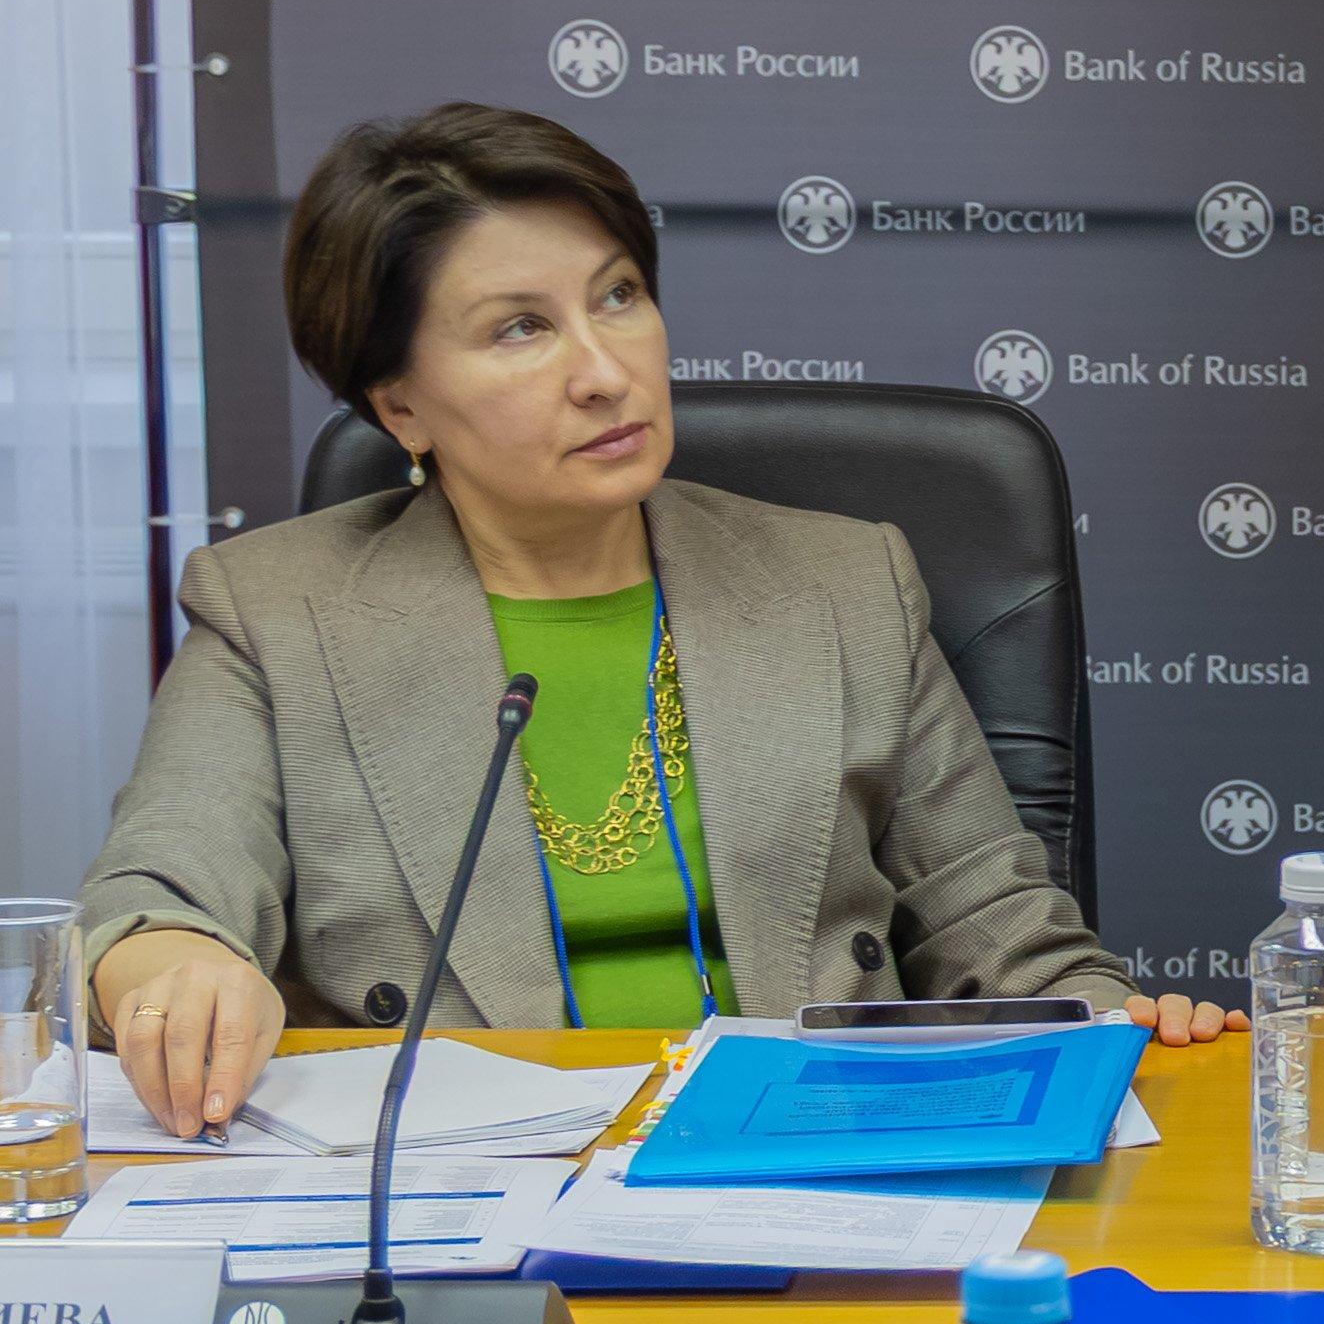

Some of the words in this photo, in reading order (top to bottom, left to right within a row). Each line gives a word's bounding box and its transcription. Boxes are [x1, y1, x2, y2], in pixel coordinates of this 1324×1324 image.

[644, 44, 726, 76] Банк
[736, 45, 859, 78] России
[1064, 48, 1146, 81] Bank
[1155, 49, 1192, 82] of
[1201, 52, 1305, 84] Russia
[872, 200, 954, 232] Банк
[963, 201, 1085, 233] России
[668, 357, 731, 381] анк
[741, 350, 865, 382] России
[1067, 352, 1149, 385] Bank
[1158, 353, 1195, 386] of
[1204, 355, 1307, 387] Russia
[1086, 652, 1152, 684] ank
[1161, 652, 1198, 684] of
[1206, 654, 1311, 685] Russia
[1164, 947, 1200, 979] of
